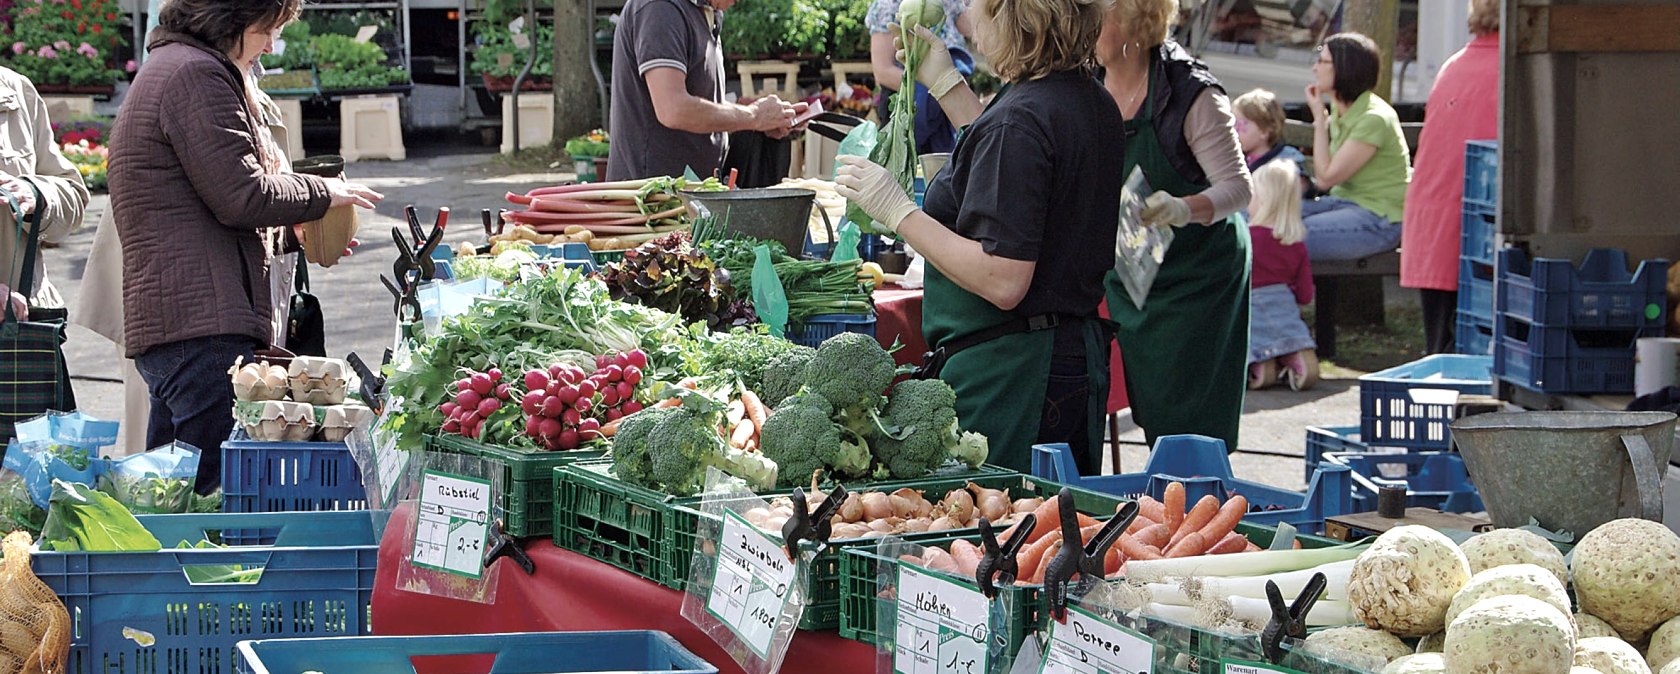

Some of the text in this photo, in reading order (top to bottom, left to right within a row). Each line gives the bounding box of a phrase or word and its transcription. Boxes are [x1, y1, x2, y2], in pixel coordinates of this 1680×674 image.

[438, 485, 480, 501] Rübstiel
[437, 505, 444, 515] D
[740, 534, 784, 574] Zwiebeln
[915, 591, 951, 620] Möhren
[919, 639, 930, 653] 1
[1226, 664, 1258, 674] Warenart
